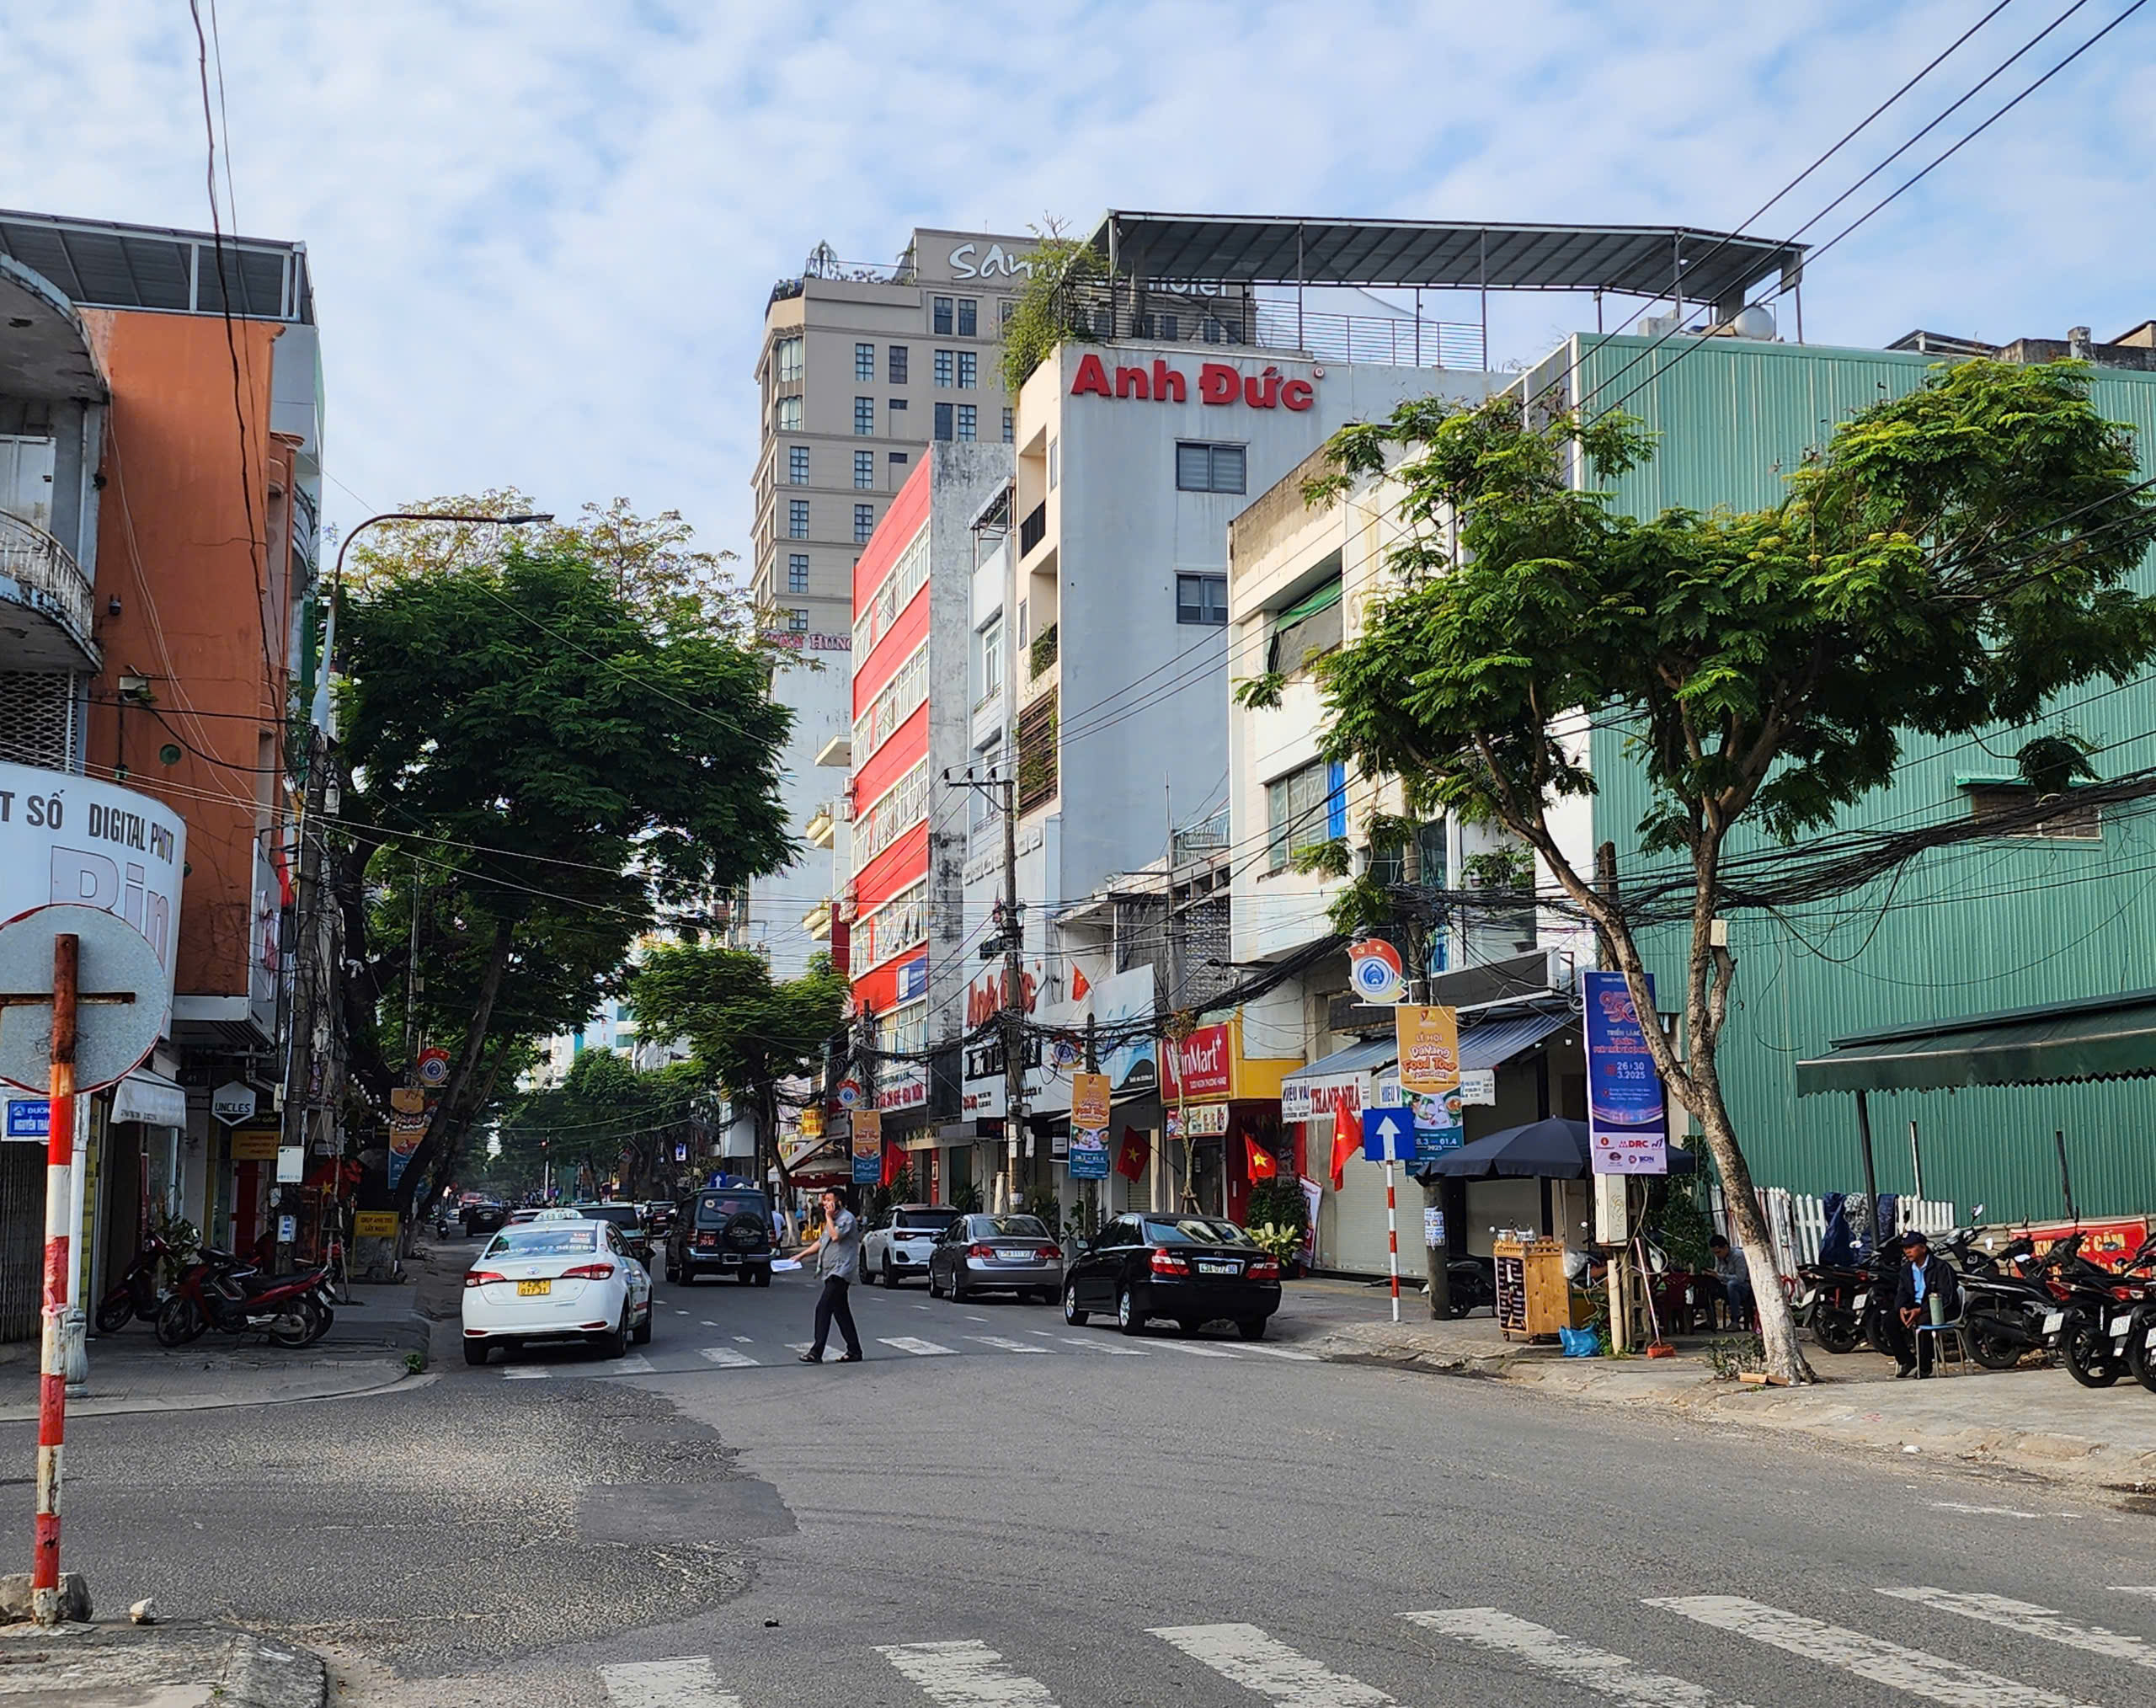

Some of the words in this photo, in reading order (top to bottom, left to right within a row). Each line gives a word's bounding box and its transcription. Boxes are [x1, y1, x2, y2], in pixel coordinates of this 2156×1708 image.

[1070, 354, 1187, 403] Anh
[1198, 366, 1315, 411] Đức
[26, 789, 65, 830] SỐ
[88, 803, 146, 851] DIGITAL
[150, 822, 174, 865] PHOTO
[1401, 1056, 1430, 1073] Food
[1617, 1061, 1629, 1070] 26
[1634, 1061, 1645, 1070] 30
[1617, 1070, 1646, 1079] 3.2025
[215, 1102, 251, 1113] UNCLES
[2033, 1239, 2056, 1256] KH
